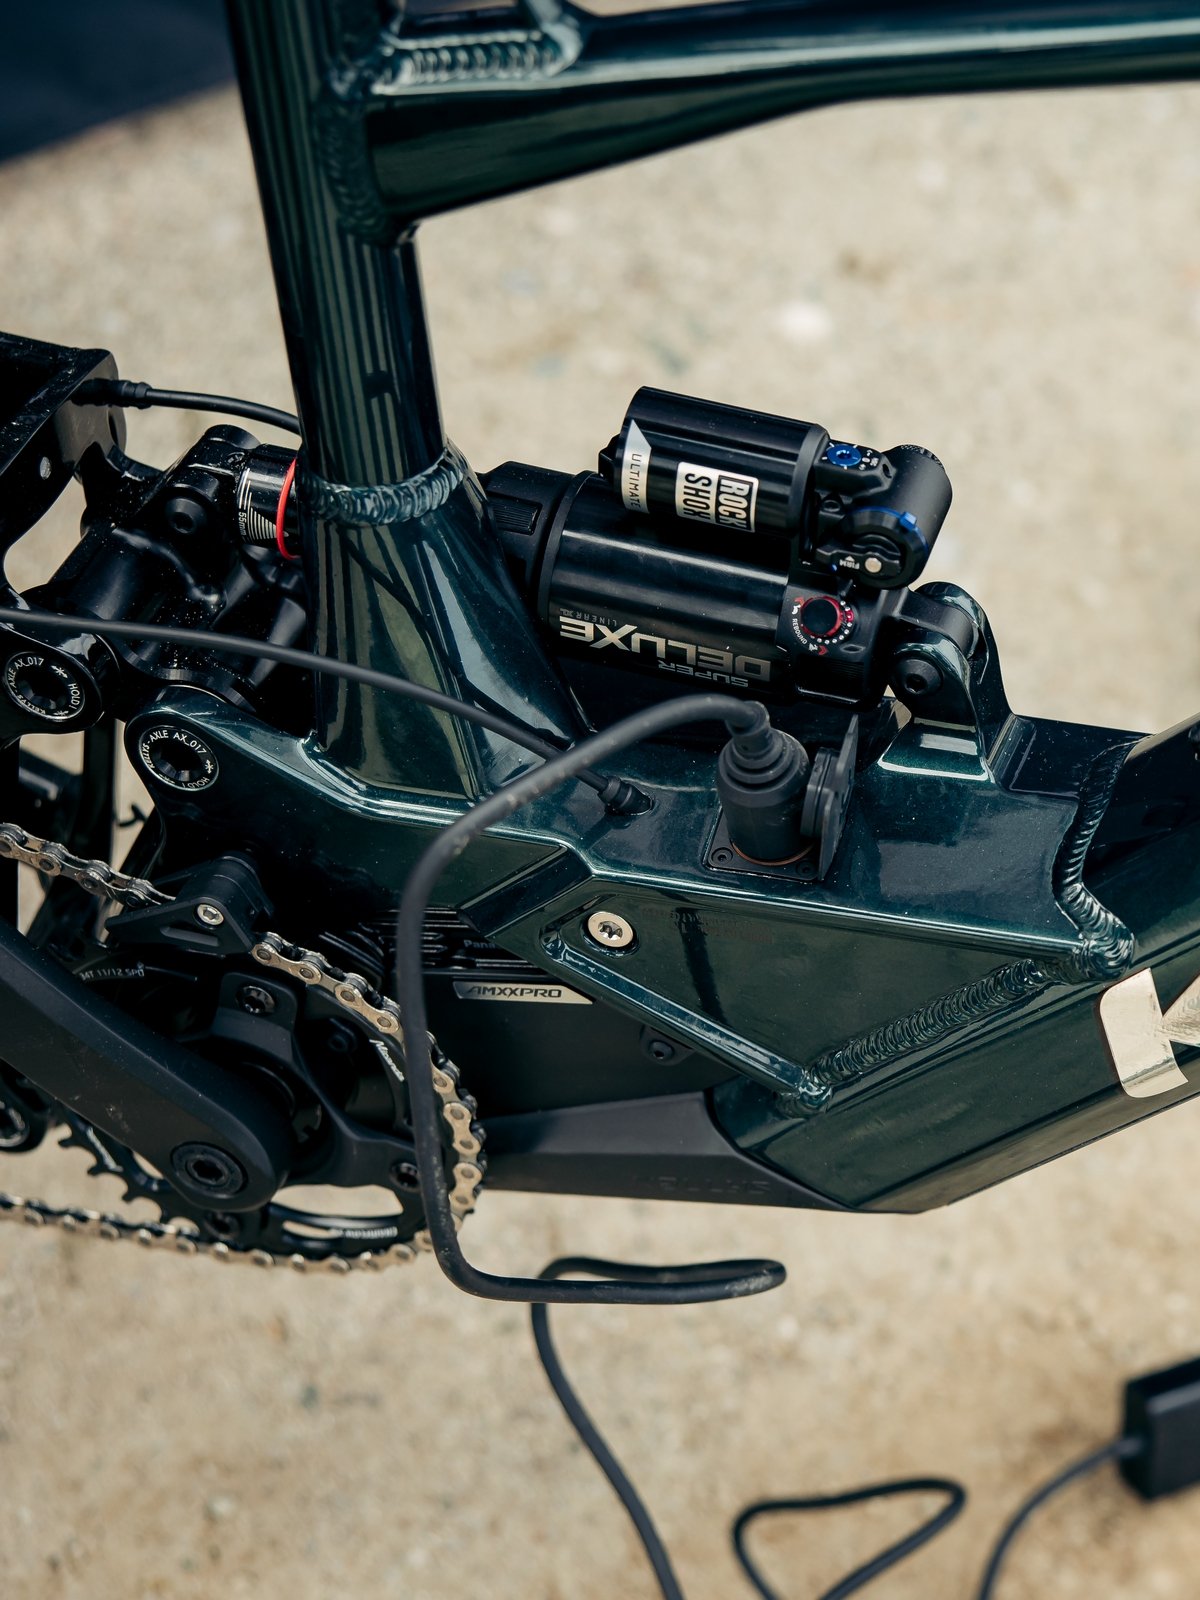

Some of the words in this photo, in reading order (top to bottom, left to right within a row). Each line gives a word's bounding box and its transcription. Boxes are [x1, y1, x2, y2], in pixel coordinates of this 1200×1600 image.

[629, 453, 642, 508] ULTIMATE
[682, 472, 713, 520] SHOX
[717, 477, 752, 529] ROCK
[559, 616, 771, 682] DELUXE
[792, 618, 808, 645] REBOUND
[658, 660, 749, 688] SUPER
